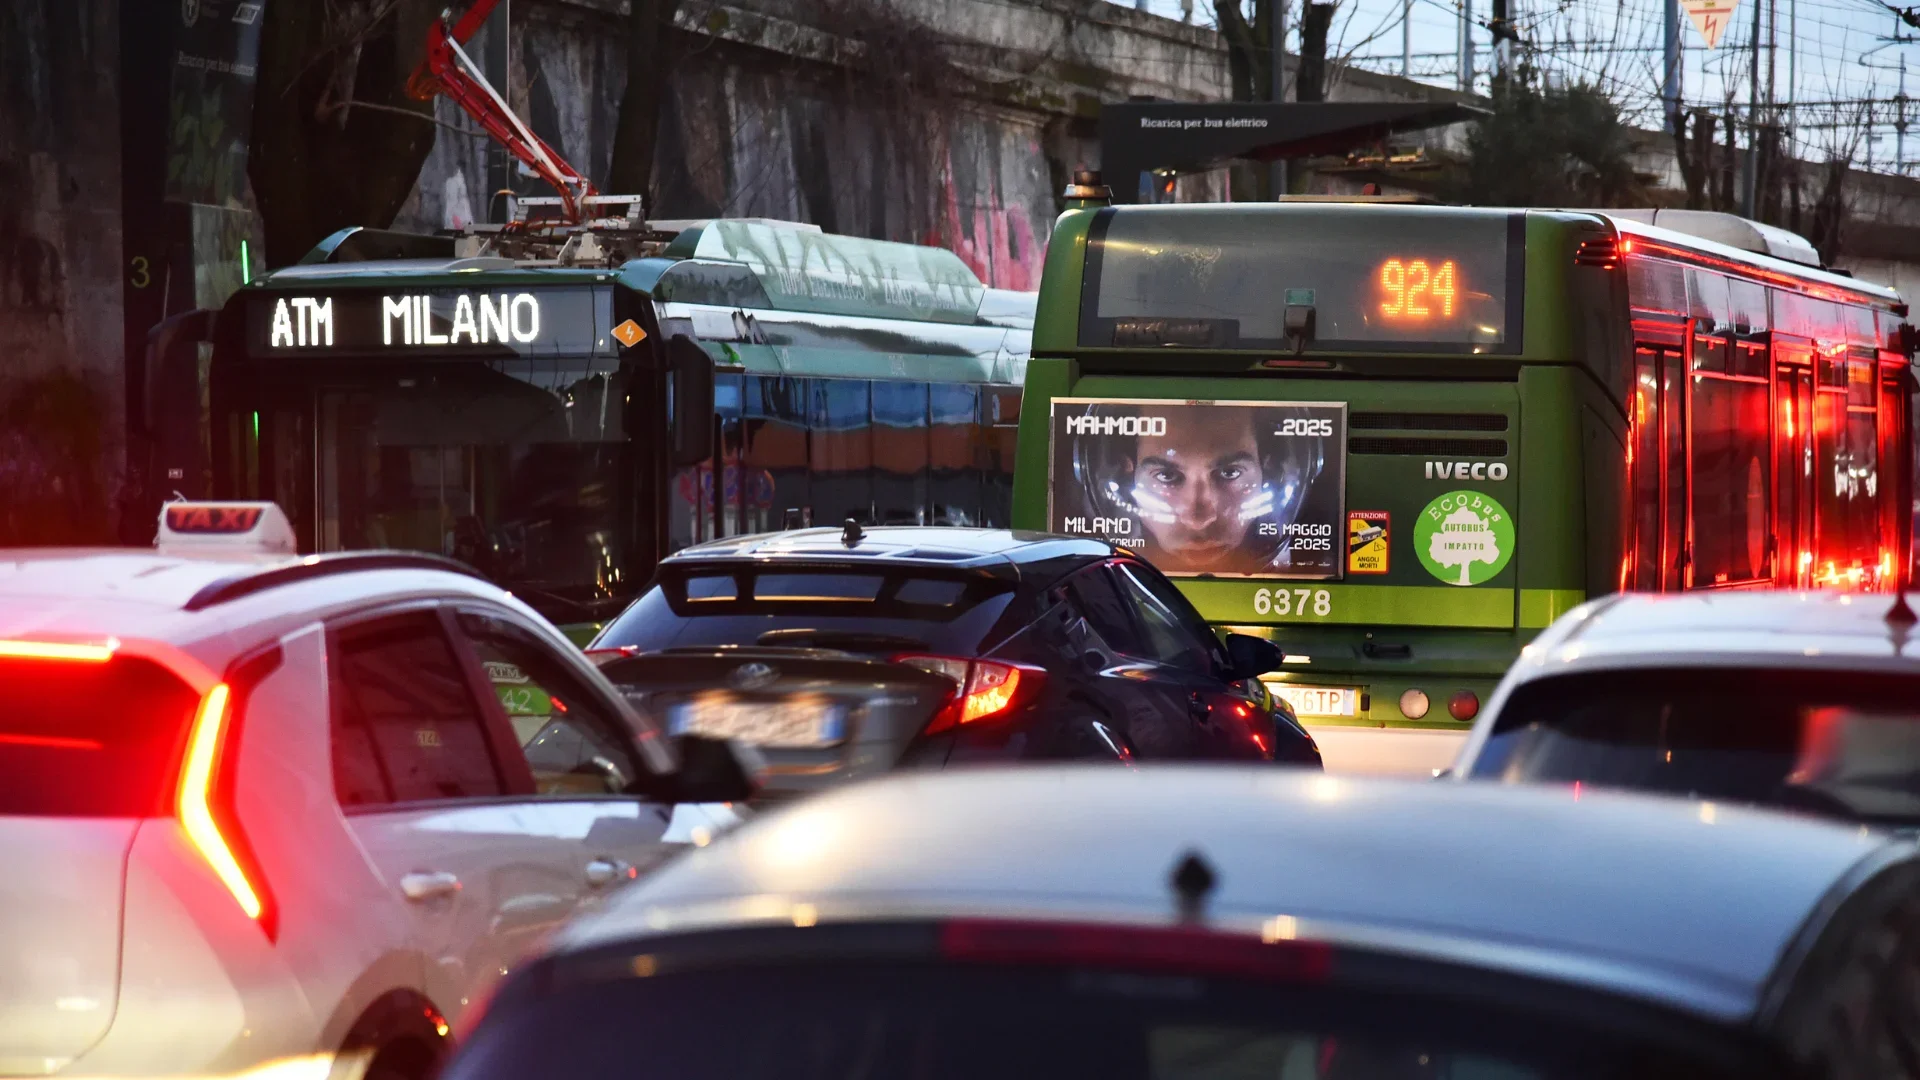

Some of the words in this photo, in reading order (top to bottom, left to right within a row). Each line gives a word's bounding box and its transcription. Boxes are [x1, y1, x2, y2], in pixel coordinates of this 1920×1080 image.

[1141, 118, 1182, 128] Ricarica
[1184, 120, 1202, 130] per
[1204, 118, 1223, 128] bus
[1225, 118, 1268, 128] elettrico
[131, 256, 149, 288] 3
[1382, 261, 1455, 315] 924
[272, 297, 333, 346] ATM
[383, 294, 538, 345] MILANO
[1066, 415, 1166, 436] MAHMOOD
[1425, 461, 1508, 481] IVECO
[170, 506, 258, 529] TAXI
[1064, 517, 1131, 534] MILANO
[1444, 523, 1484, 532] AUTOBUS
[1259, 523, 1278, 535] 25
[1282, 523, 1332, 536] MAGGIO
[1444, 542, 1484, 550] IMPATTO
[1254, 588, 1331, 616] 6378
[502, 689, 532, 712] 42
